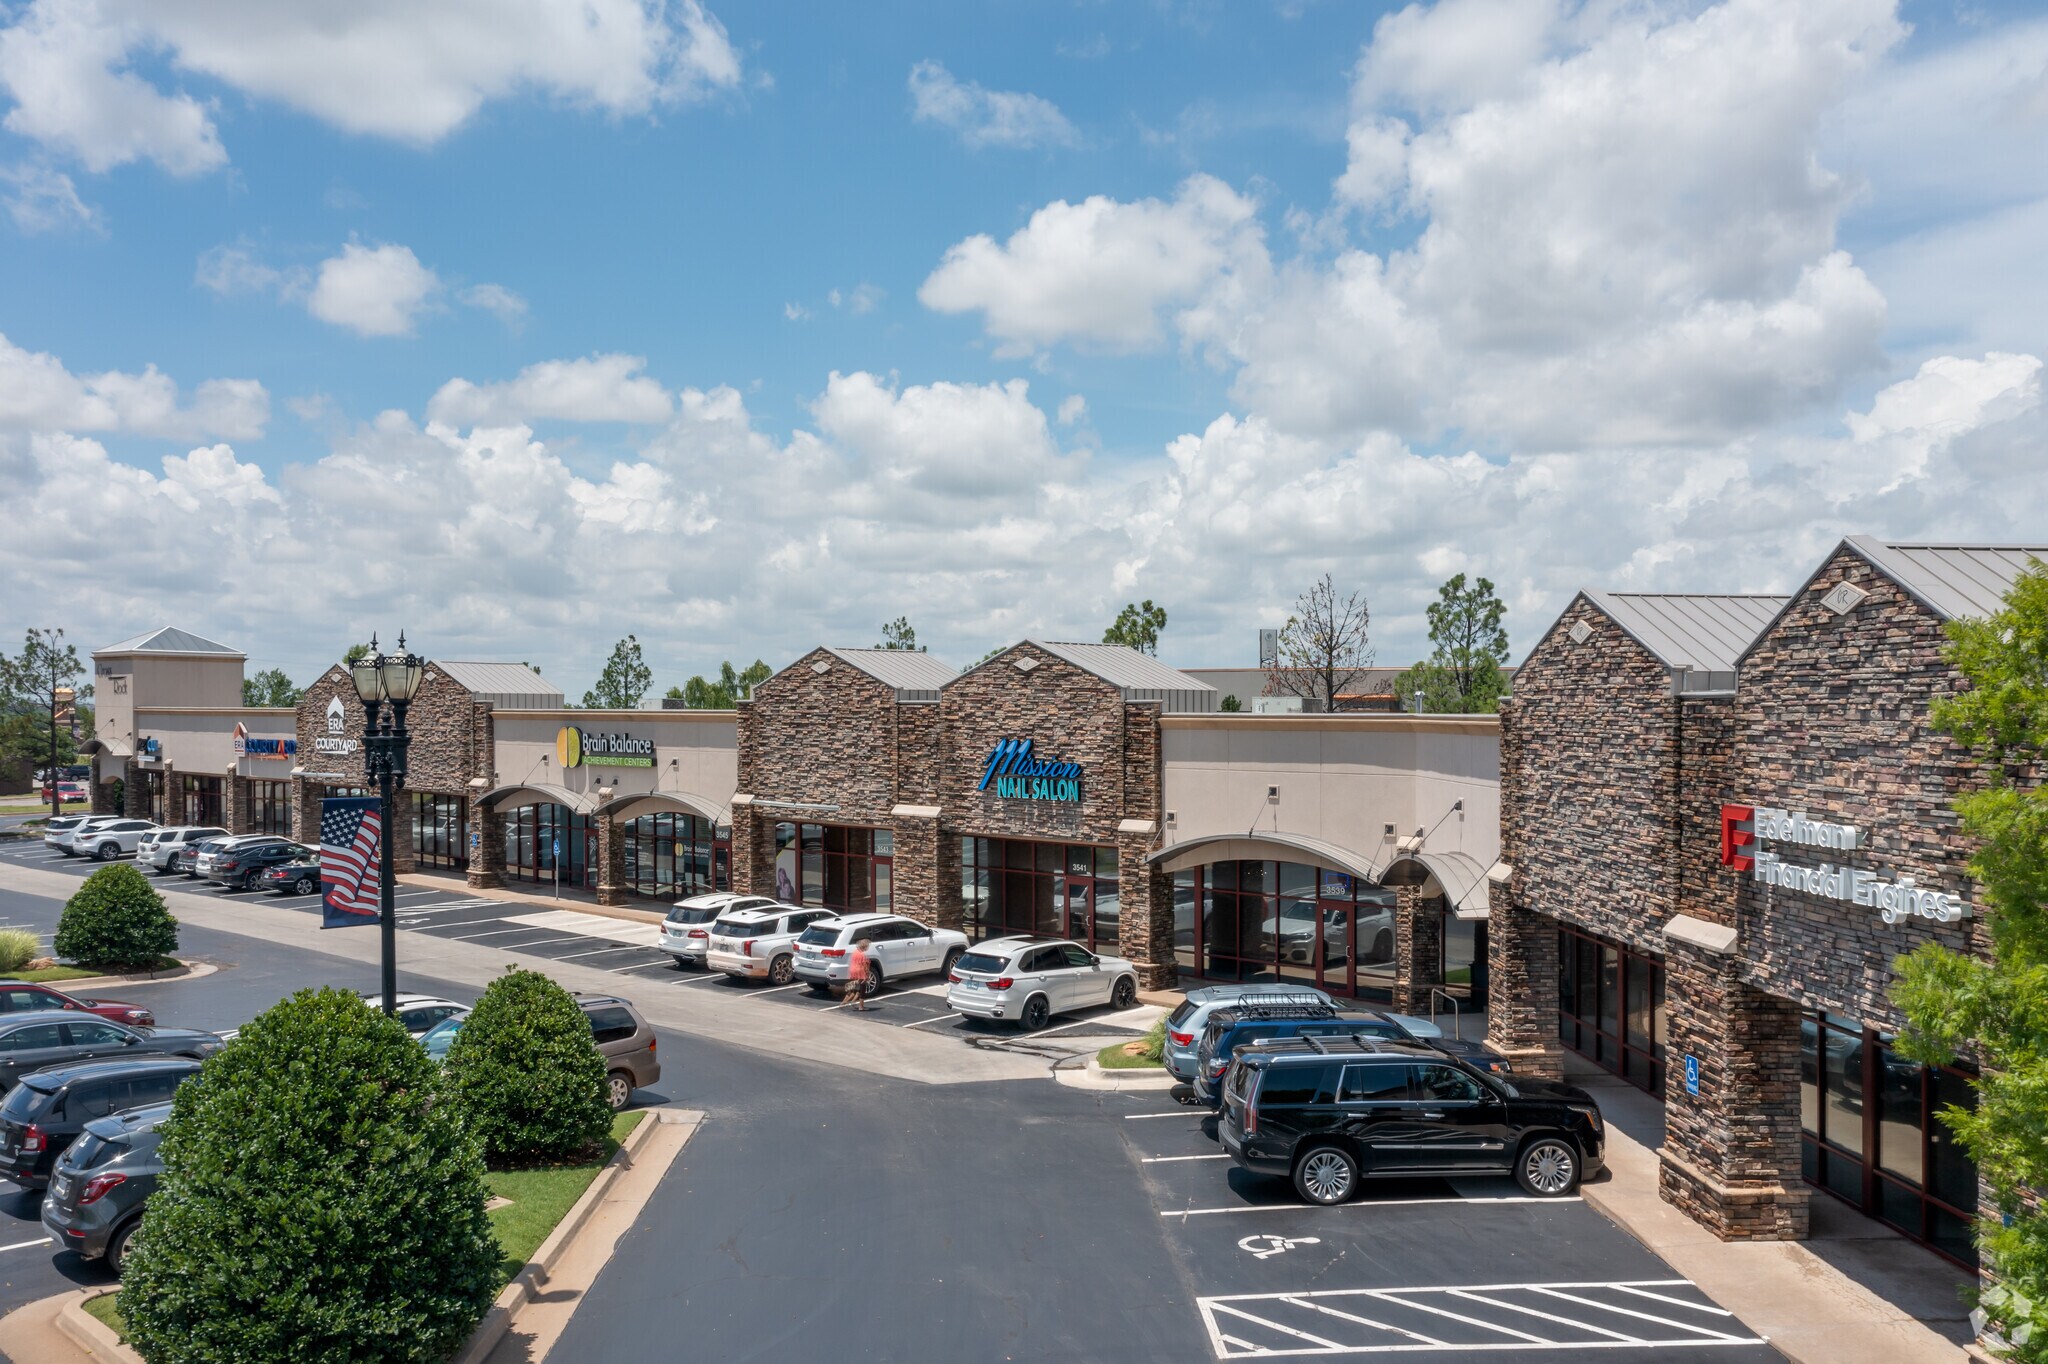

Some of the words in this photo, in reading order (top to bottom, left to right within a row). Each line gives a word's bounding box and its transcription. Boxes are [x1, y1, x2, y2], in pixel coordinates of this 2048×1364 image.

[328, 718, 344, 730] ERA
[234, 740, 245, 750] ERA
[315, 738, 358, 753] COURTYARD
[582, 733, 608, 752] Brain
[610, 733, 652, 754] Balance
[583, 756, 622, 765] ACHIEVEMENT
[624, 757, 652, 767] CENTERS
[977, 738, 1083, 791] Mission
[997, 777, 1030, 799] NAIL
[1032, 778, 1080, 801] SALON
[716, 830, 729, 839] 3545
[1755, 807, 1856, 850] Edelman
[1072, 863, 1087, 871] 3541
[1326, 886, 1346, 895] 3539
[1754, 851, 1853, 900] Financial
[1852, 869, 1961, 925] Engines
